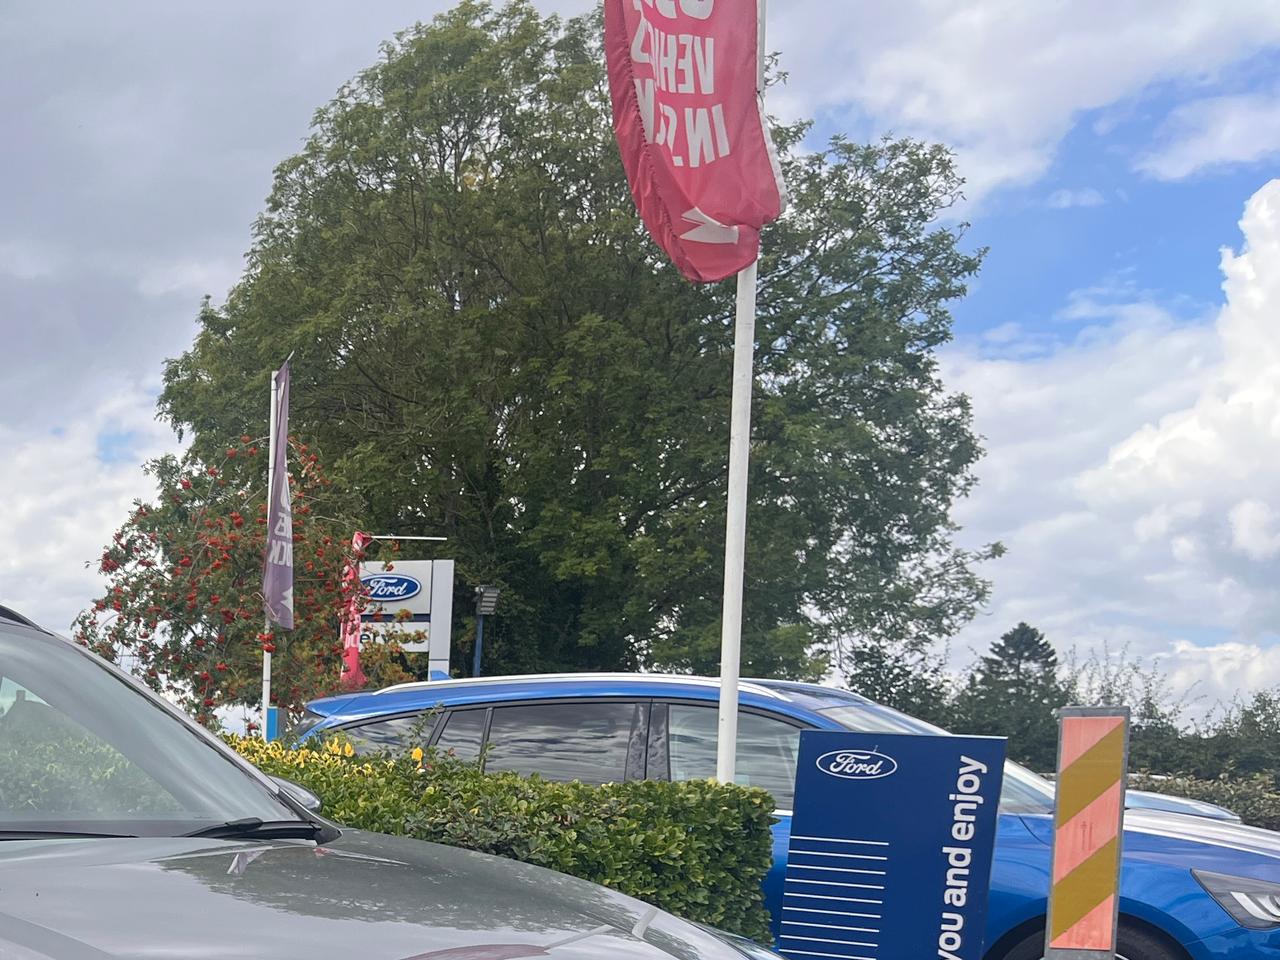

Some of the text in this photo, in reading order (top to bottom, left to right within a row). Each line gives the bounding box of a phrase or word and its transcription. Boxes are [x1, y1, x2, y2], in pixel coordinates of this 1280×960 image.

[829, 753, 884, 775] Ford
[949, 755, 988, 841] enjoy
[942, 846, 972, 908] and
